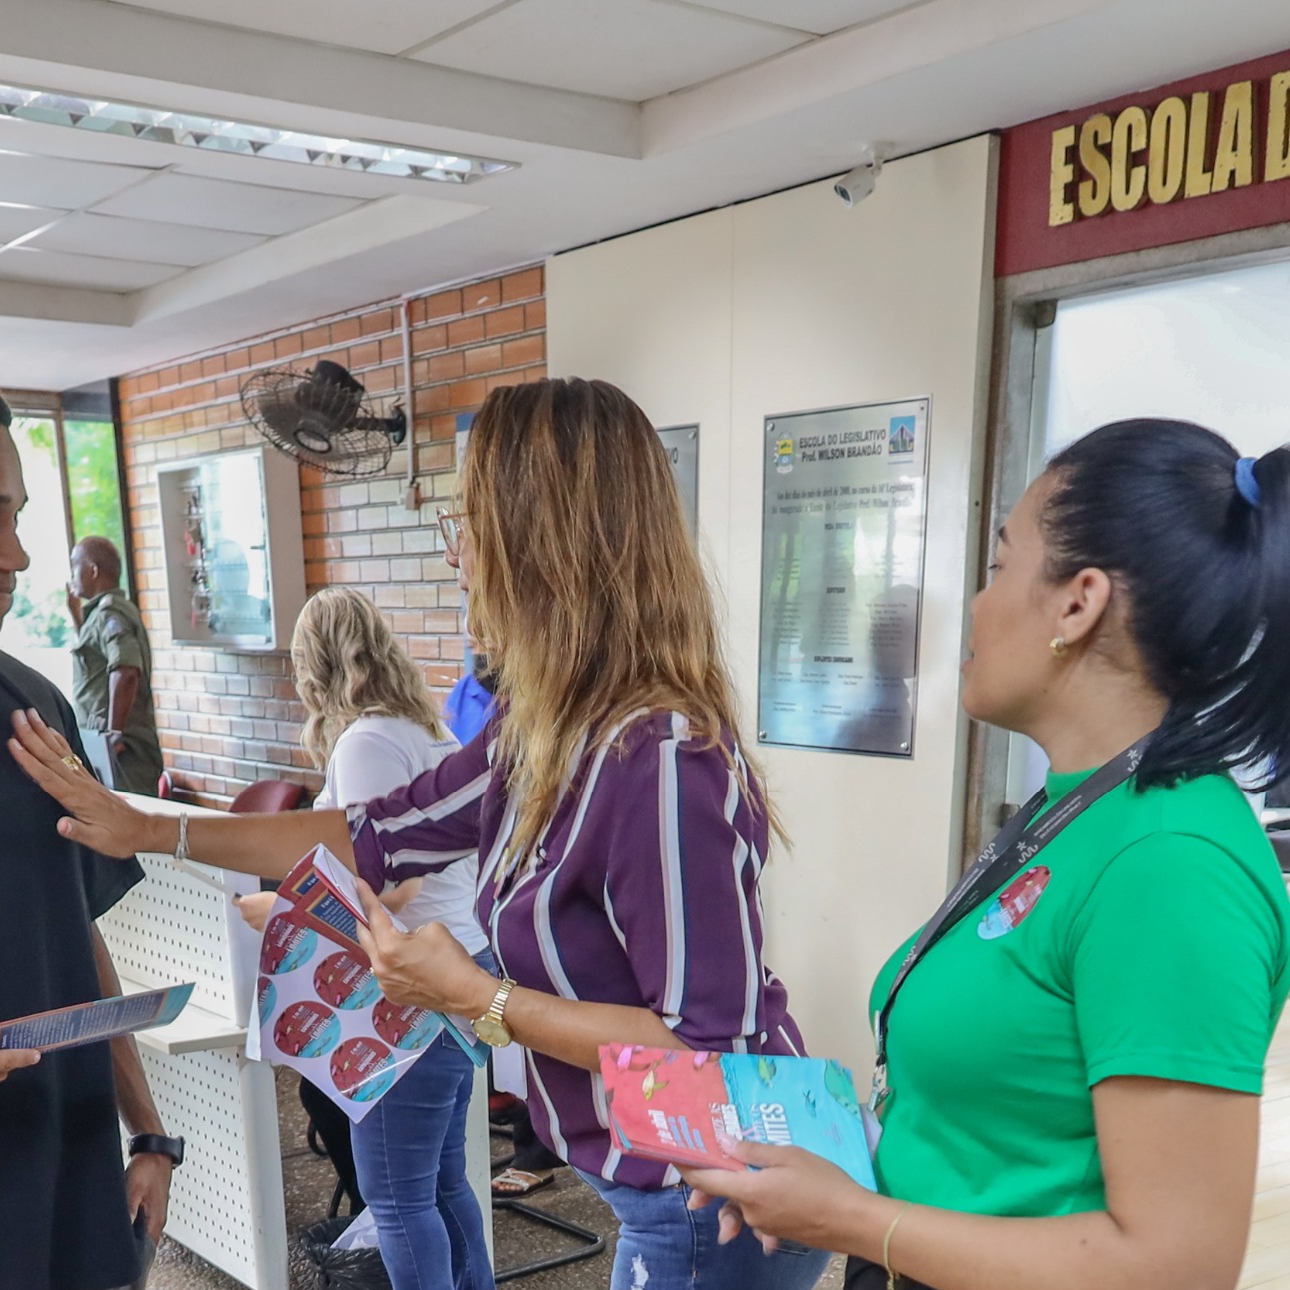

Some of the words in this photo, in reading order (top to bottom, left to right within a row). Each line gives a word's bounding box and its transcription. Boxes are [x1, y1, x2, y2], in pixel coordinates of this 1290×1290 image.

[1048, 80, 1254, 228] ESCOLA
[799, 436, 826, 449] ESCOLA
[828, 433, 838, 446] DO
[839, 428, 887, 444] LEGISLATIVO
[818, 448, 845, 461] WILSON
[847, 444, 883, 458] BRANDÃO
[760, 1103, 792, 1146] MITES
